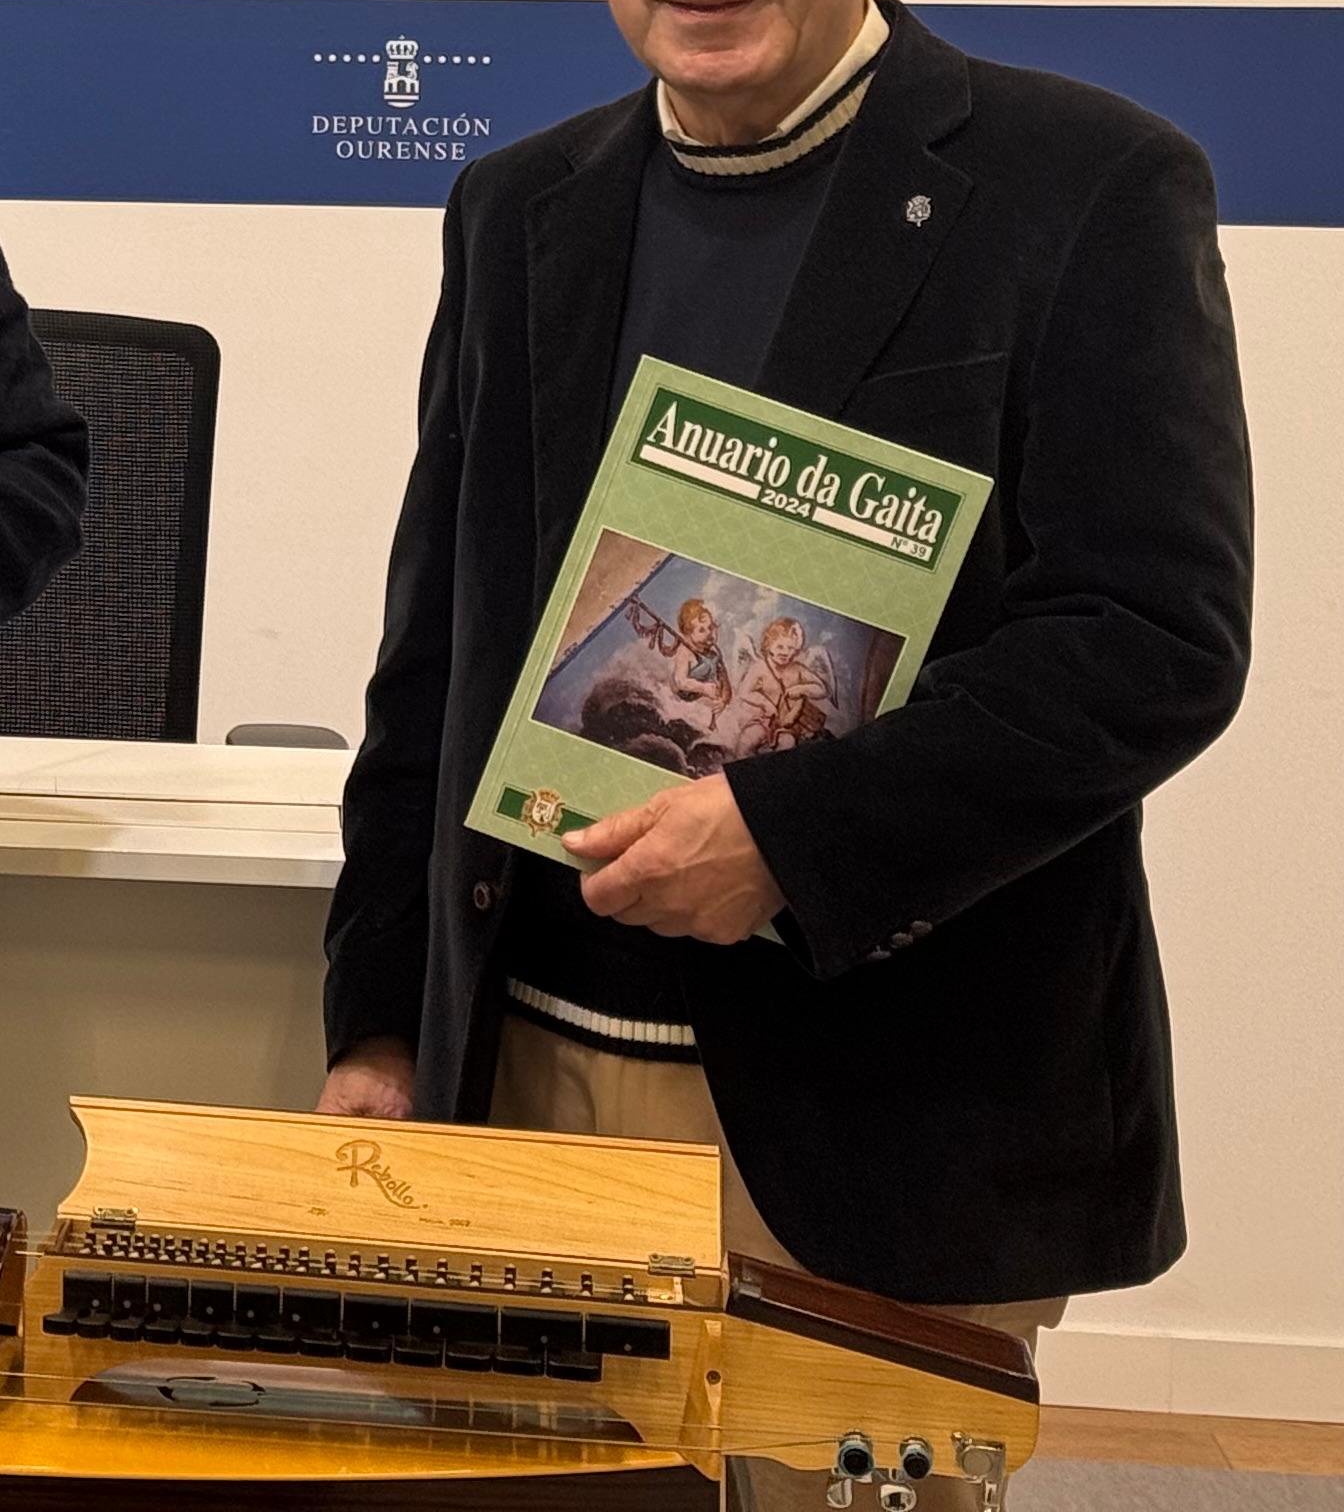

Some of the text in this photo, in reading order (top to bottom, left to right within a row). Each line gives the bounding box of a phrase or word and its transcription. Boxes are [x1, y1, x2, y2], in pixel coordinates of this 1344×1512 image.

[311, 112, 492, 138] DEPUTACIÓN
[335, 141, 467, 162] OURENSE
[646, 400, 943, 545] Anuario da Gaita
[760, 488, 813, 518] 2024
[910, 542, 928, 559] 39
[335, 1138, 422, 1210] Rebollo
